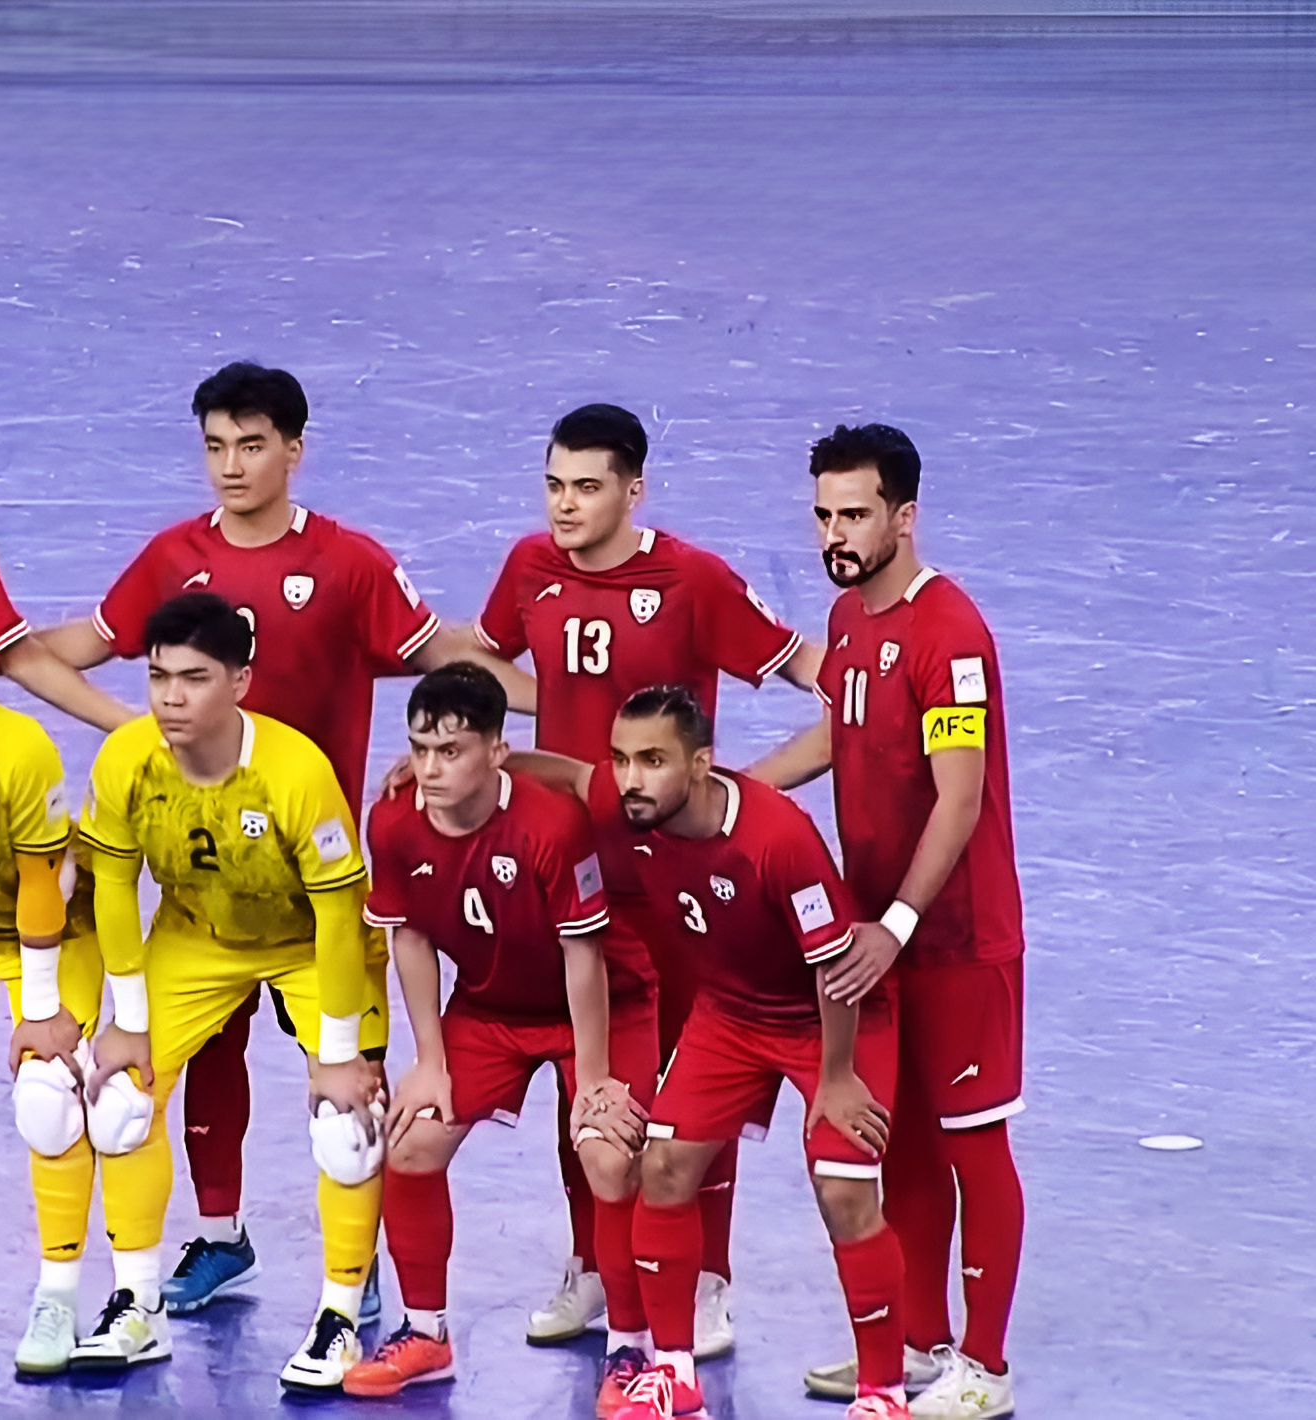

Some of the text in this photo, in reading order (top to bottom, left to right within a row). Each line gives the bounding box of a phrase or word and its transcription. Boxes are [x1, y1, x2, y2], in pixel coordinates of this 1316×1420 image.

[563, 617, 612, 675] 13
[929, 715, 975, 740] AFC
[188, 827, 221, 872] 2
[463, 887, 494, 935] 4
[677, 891, 708, 934] 3
